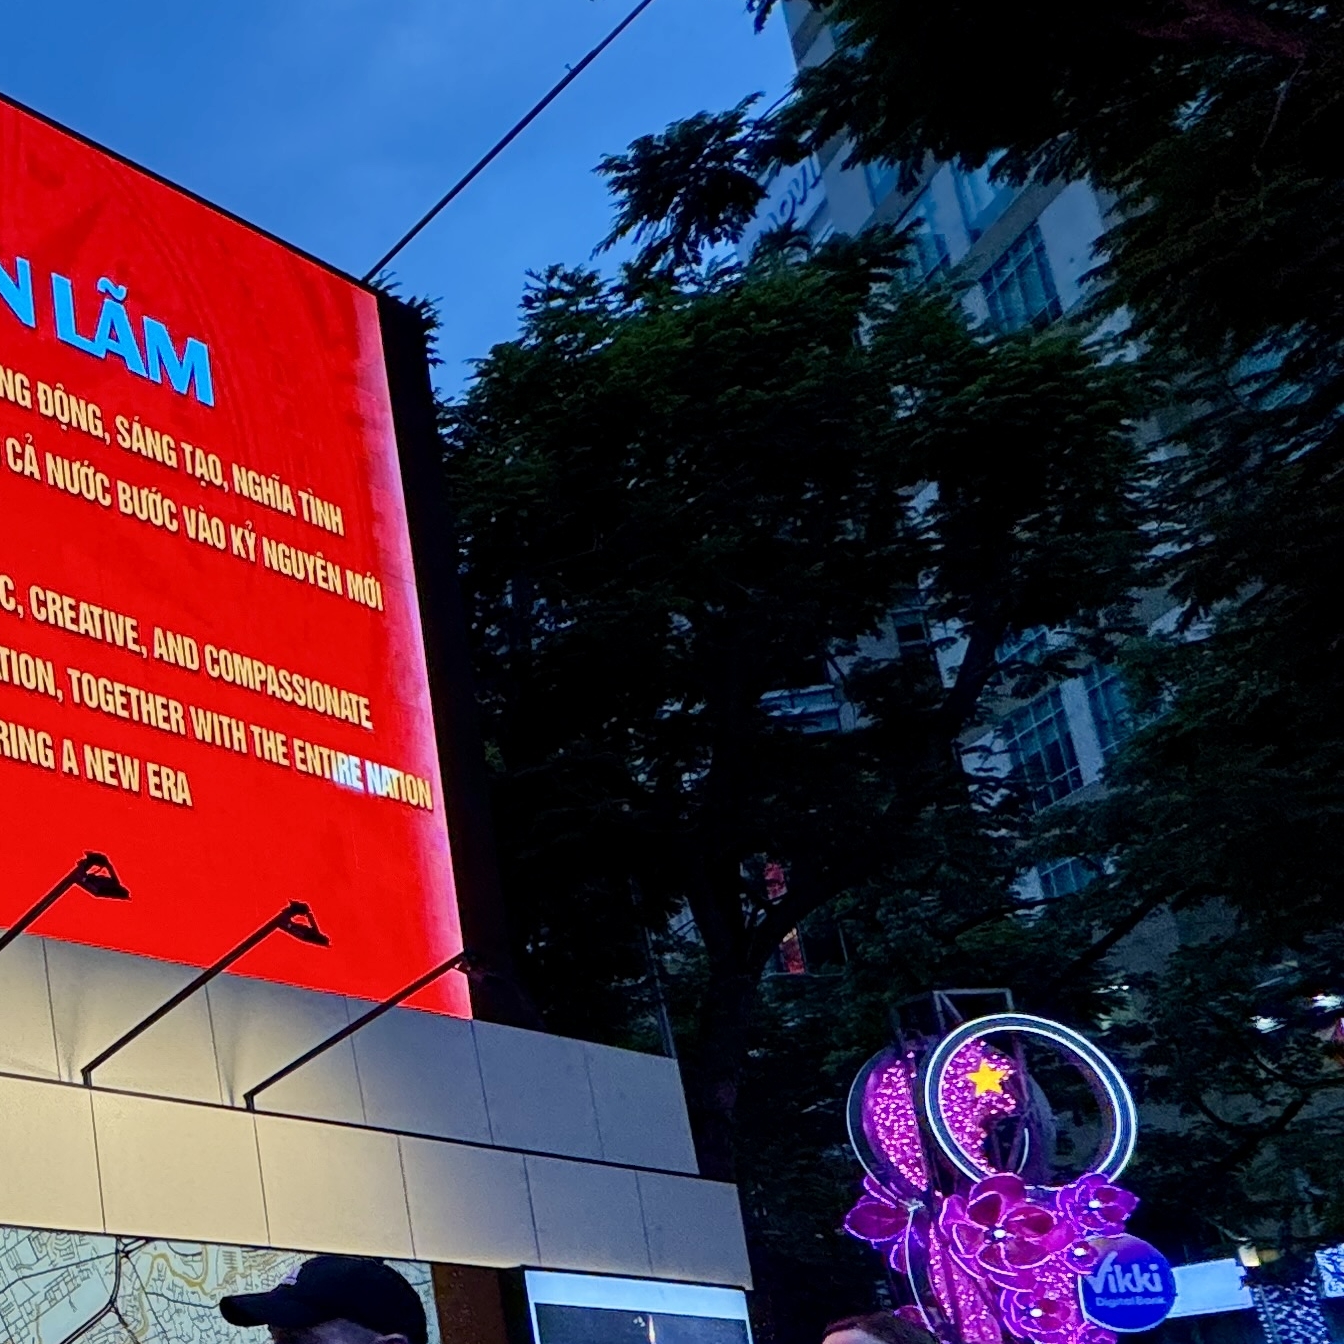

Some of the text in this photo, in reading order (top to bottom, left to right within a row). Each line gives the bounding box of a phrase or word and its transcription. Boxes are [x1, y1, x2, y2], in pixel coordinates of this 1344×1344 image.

[51, 272, 215, 408] LÃM
[5, 433, 41, 482] CẢ
[46, 452, 112, 508] NƯỚC
[117, 480, 179, 534] BƯỚC
[182, 505, 227, 551] VÀO
[230, 520, 257, 563] KỶ
[262, 536, 343, 596] NGUYÊN
[346, 569, 384, 612] MỚI
[37, 383, 111, 445] ĐỘNG,
[115, 414, 179, 469] SÁNG
[180, 441, 229, 493] TẠO,
[232, 461, 297, 517] NGHĨA
[298, 488, 345, 537] TÌNH
[29, 584, 148, 659] CREATIVE,
[153, 626, 200, 672] AND
[204, 644, 373, 730] COMPASSIONATE
[62, 738, 79, 776] A
[83, 744, 140, 792] NEW
[146, 761, 193, 807] ERA
[66, 667, 186, 736] TOGETHER
[189, 705, 248, 754] WITH
[250, 723, 290, 767] THE
[292, 737, 362, 789] ENTIRE
[365, 759, 433, 811] NATION
